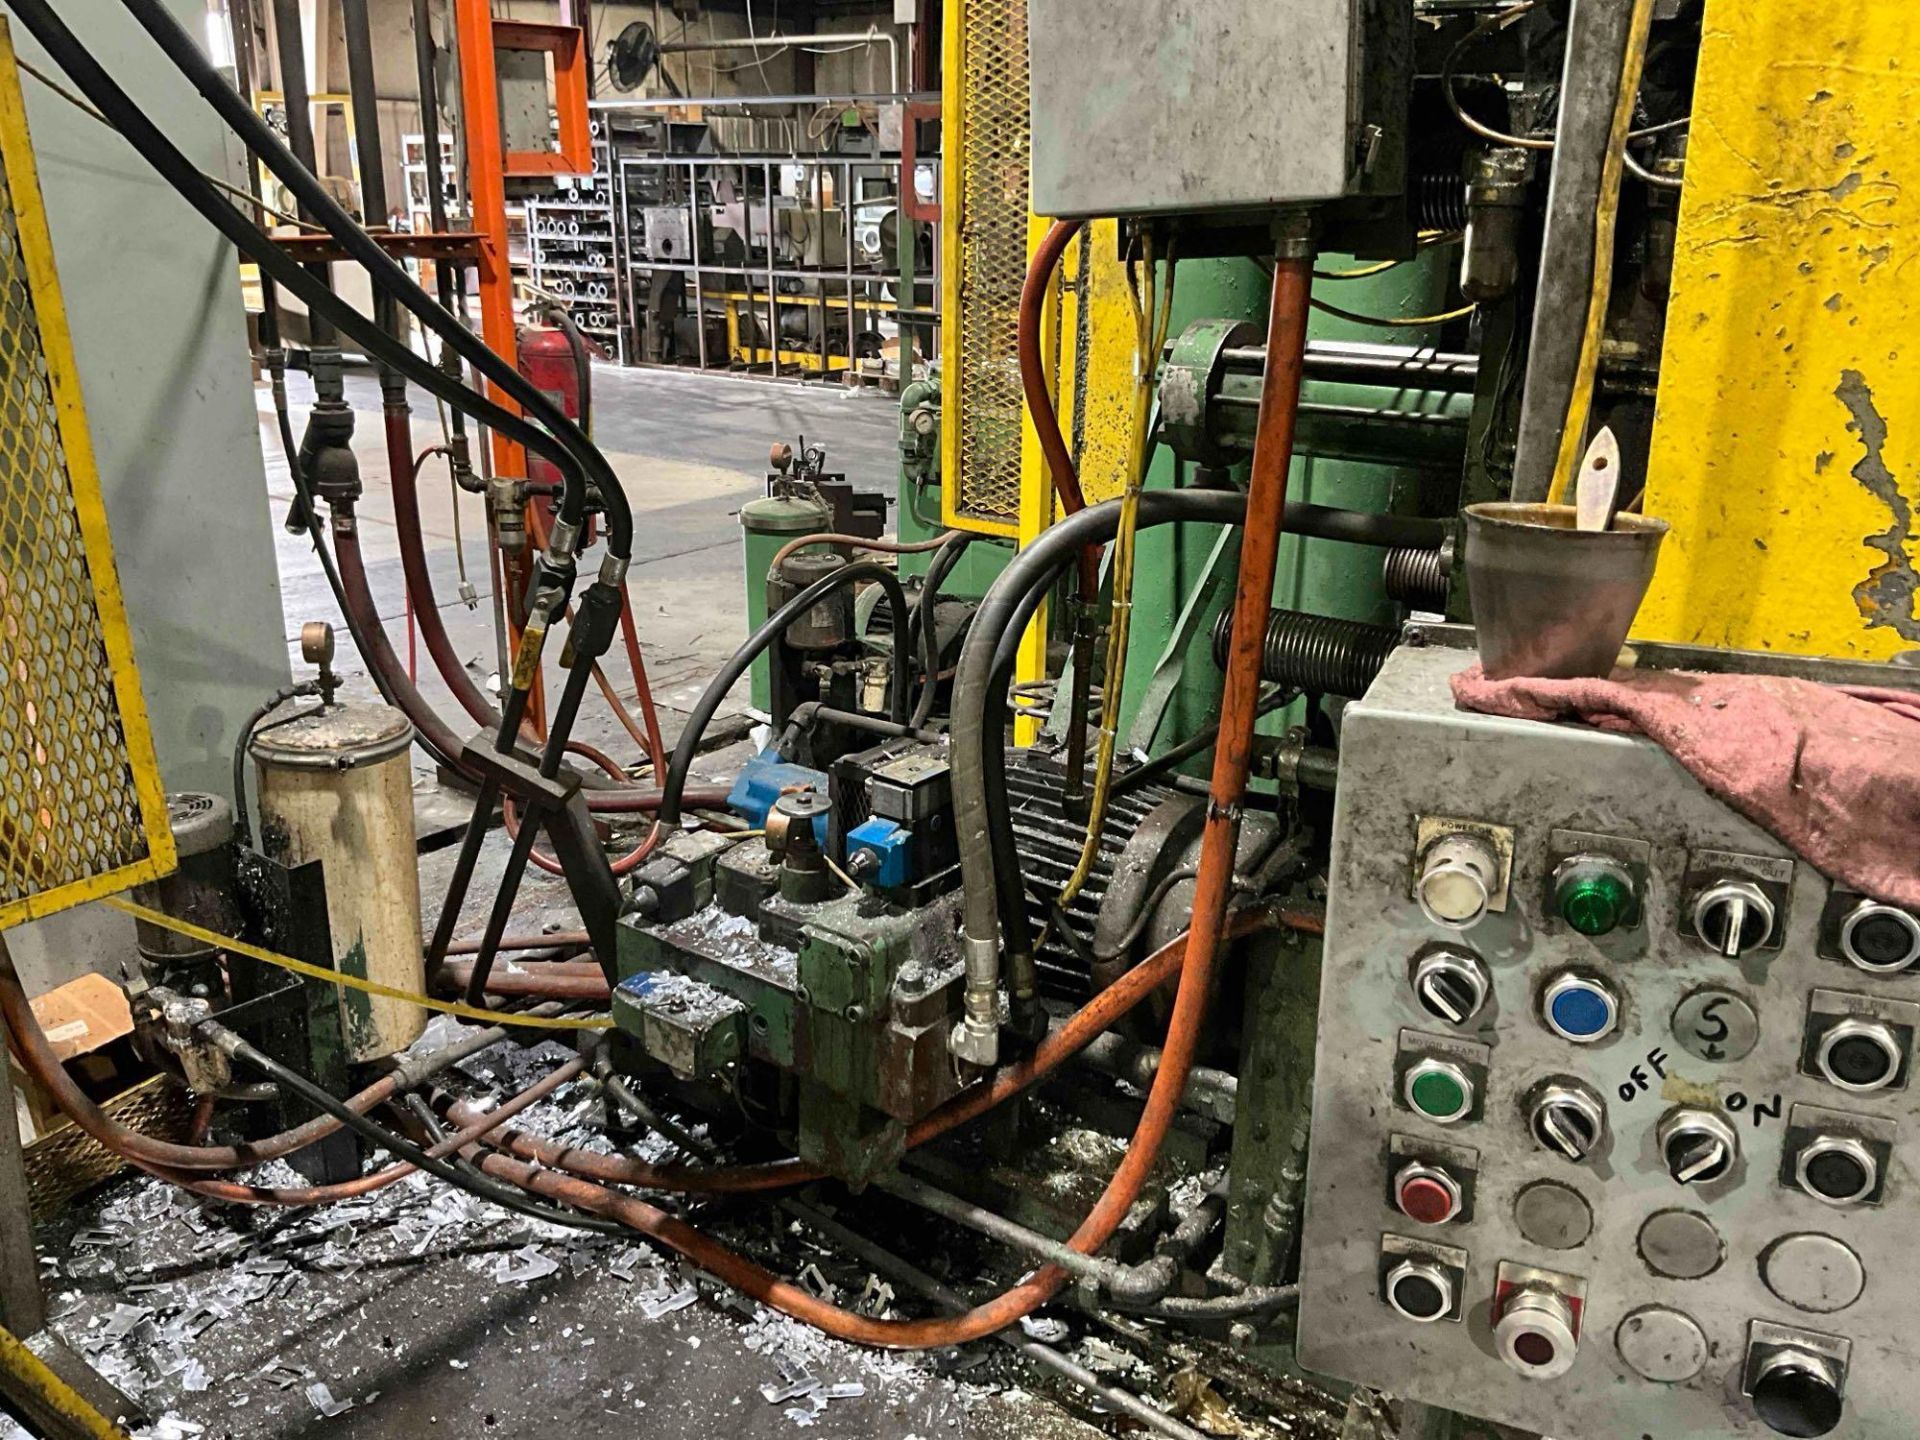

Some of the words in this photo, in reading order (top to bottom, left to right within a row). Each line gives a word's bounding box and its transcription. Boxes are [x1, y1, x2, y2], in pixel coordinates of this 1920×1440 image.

[1441, 821, 1474, 832] POWER
[1478, 825, 1493, 834] ON
[1743, 856, 1775, 869] CORE
[1761, 867, 1786, 878] OUT
[1695, 997, 1730, 1042] S
[1618, 1047, 1668, 1102] OFF
[1725, 1091, 1782, 1127] ON
